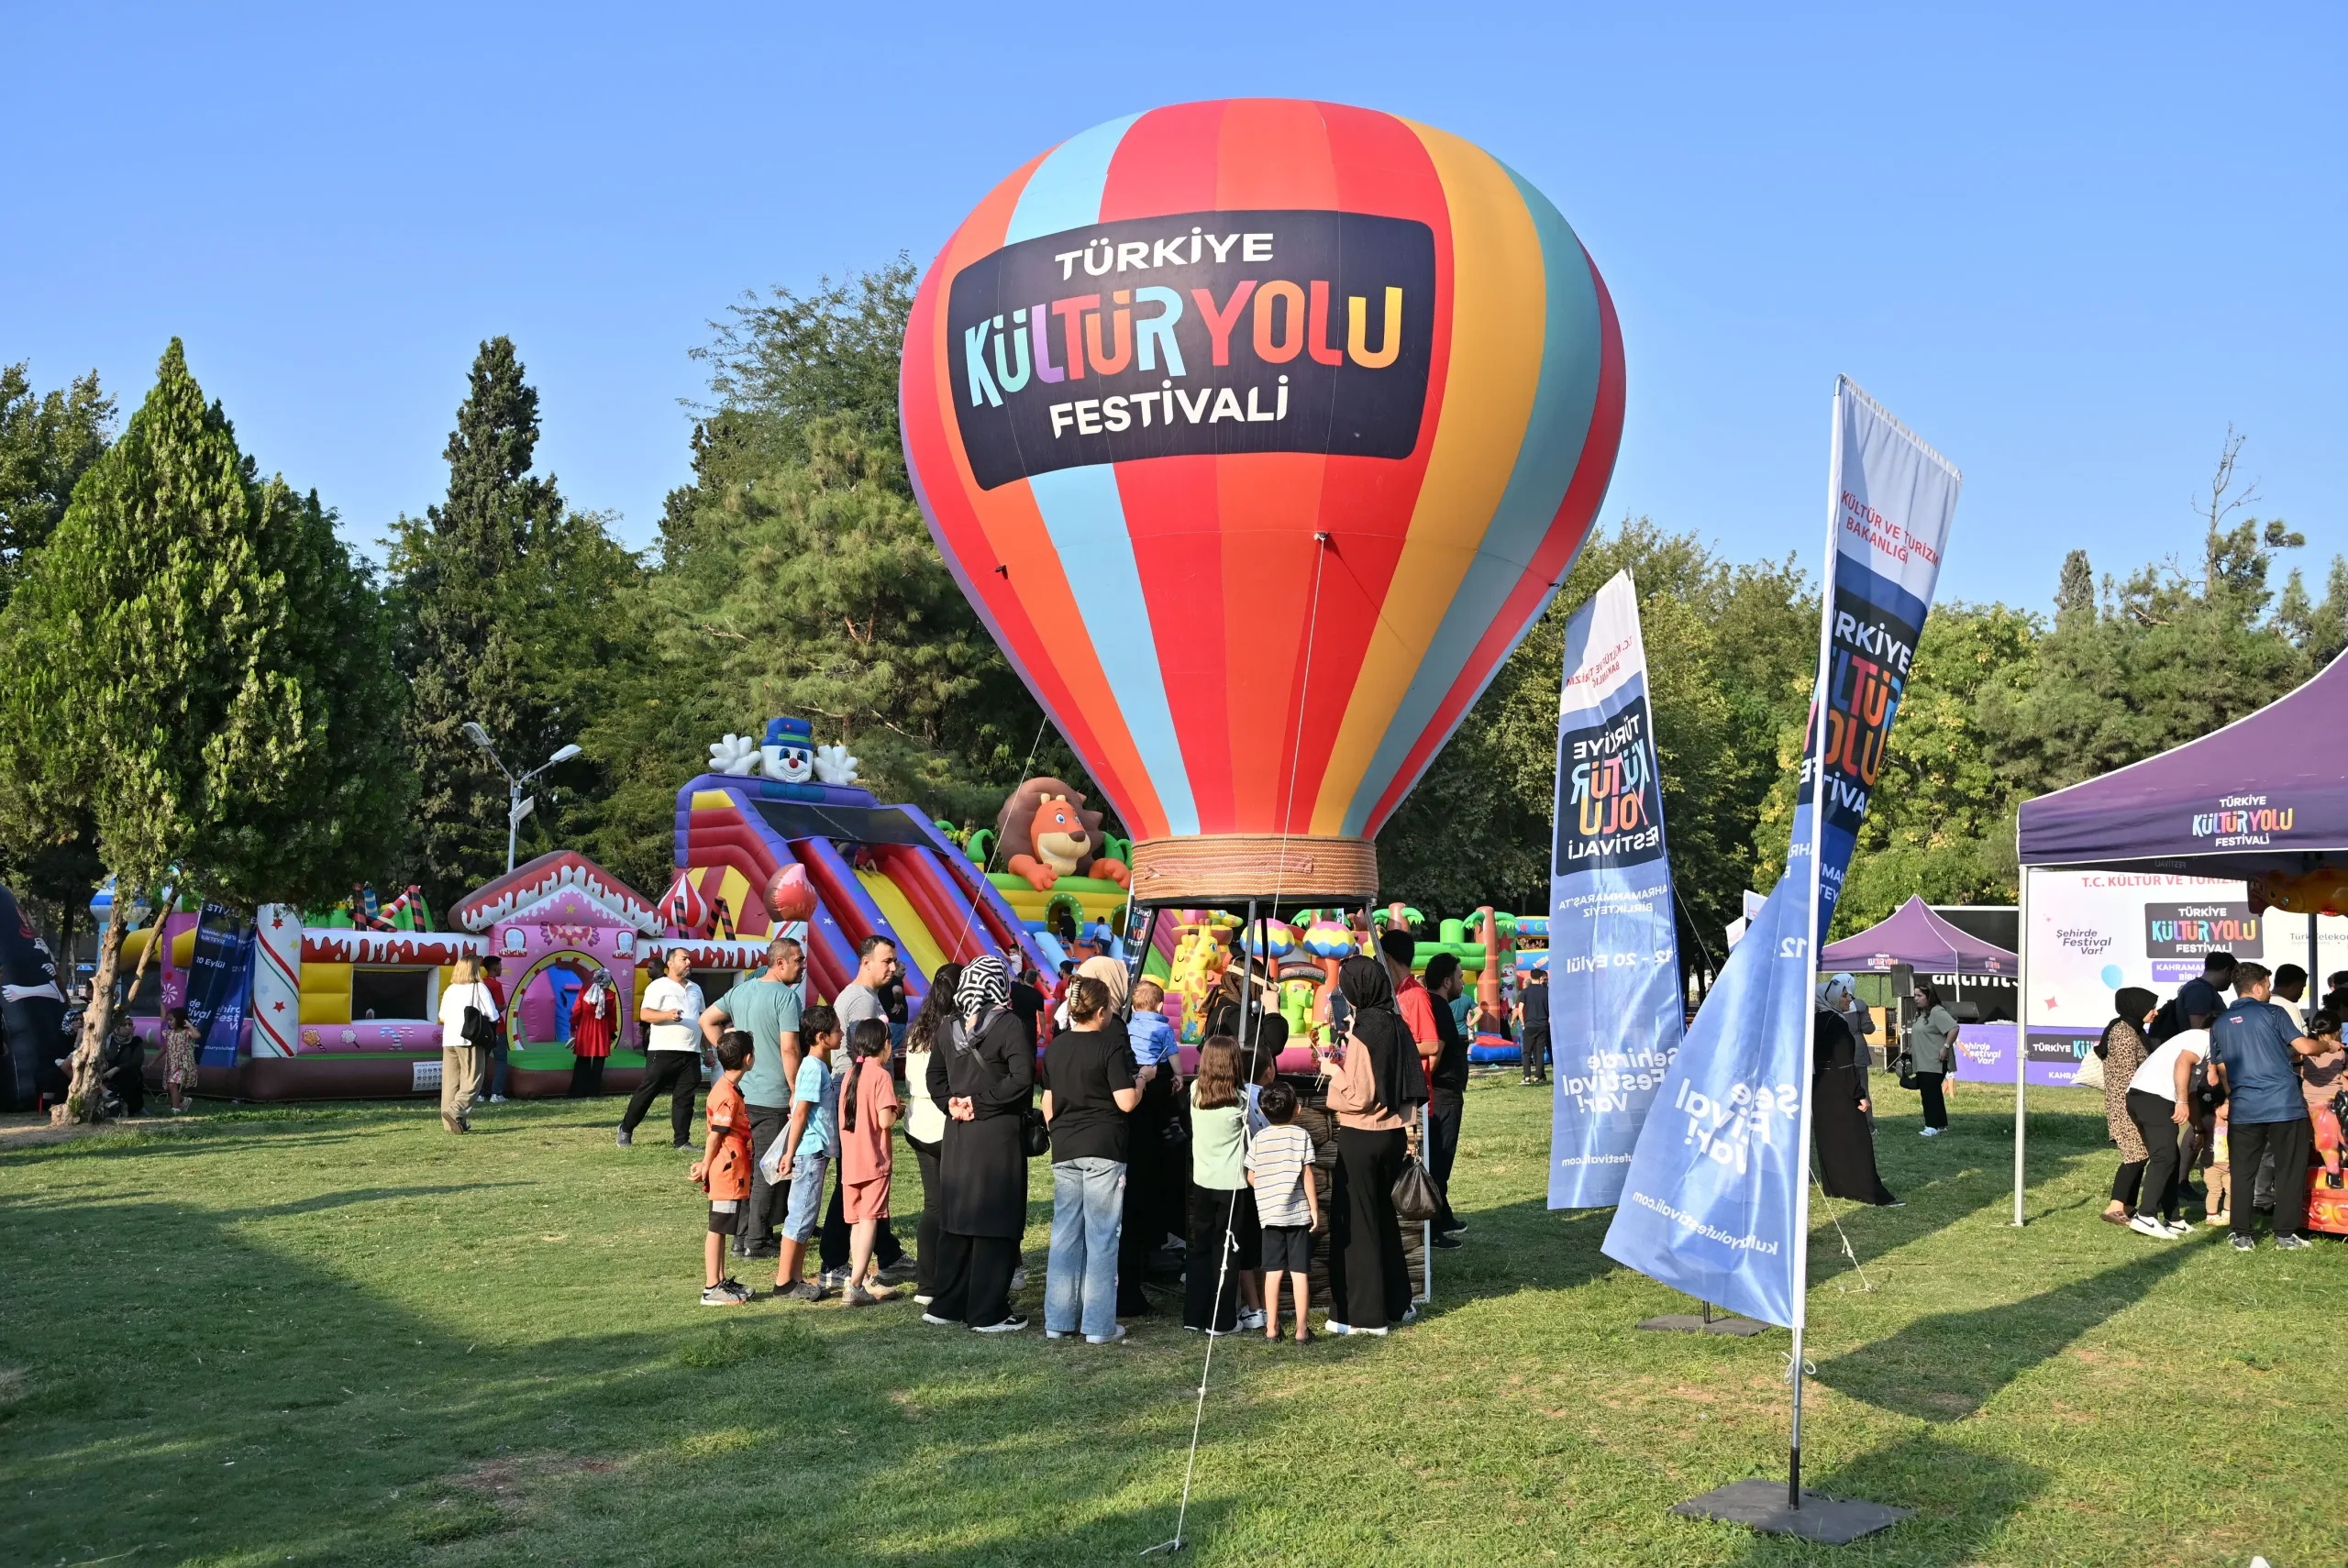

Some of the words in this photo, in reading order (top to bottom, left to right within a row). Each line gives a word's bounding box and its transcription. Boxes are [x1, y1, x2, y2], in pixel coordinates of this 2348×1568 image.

[1055, 226, 1274, 281] TÜRKİYE
[964, 286, 1187, 408] KÜLTÜR
[1191, 279, 1403, 369] YOLU
[1049, 375, 1290, 439] FESTİVALİ
[1841, 490, 1882, 529] KÜLTÜR
[1885, 520, 1900, 539] VE
[1904, 530, 1939, 569] TURİZM
[1834, 601, 1911, 675] RKİYE
[2220, 794, 2267, 808] TÜRKİYE
[2192, 811, 2248, 837] KÜLTÜR
[2249, 808, 2293, 831] YOLU
[2215, 834, 2270, 847] FESTİVALİ
[2082, 878, 2105, 888] T.C.
[2108, 873, 2161, 887] KÜLTÜR
[2165, 874, 2183, 886] VE
[2177, 906, 2227, 917] TÜRKİYE
[2056, 928, 2098, 939] Şehirde
[2152, 920, 2210, 943] KÜLTÜR
[2210, 920, 2256, 941] YOLU
[2063, 936, 2111, 946] Festival
[2176, 942, 2232, 953] FESTİVALİ
[2080, 946, 2103, 955] Var!
[2032, 1043, 2071, 1053] TÜRKİYE
